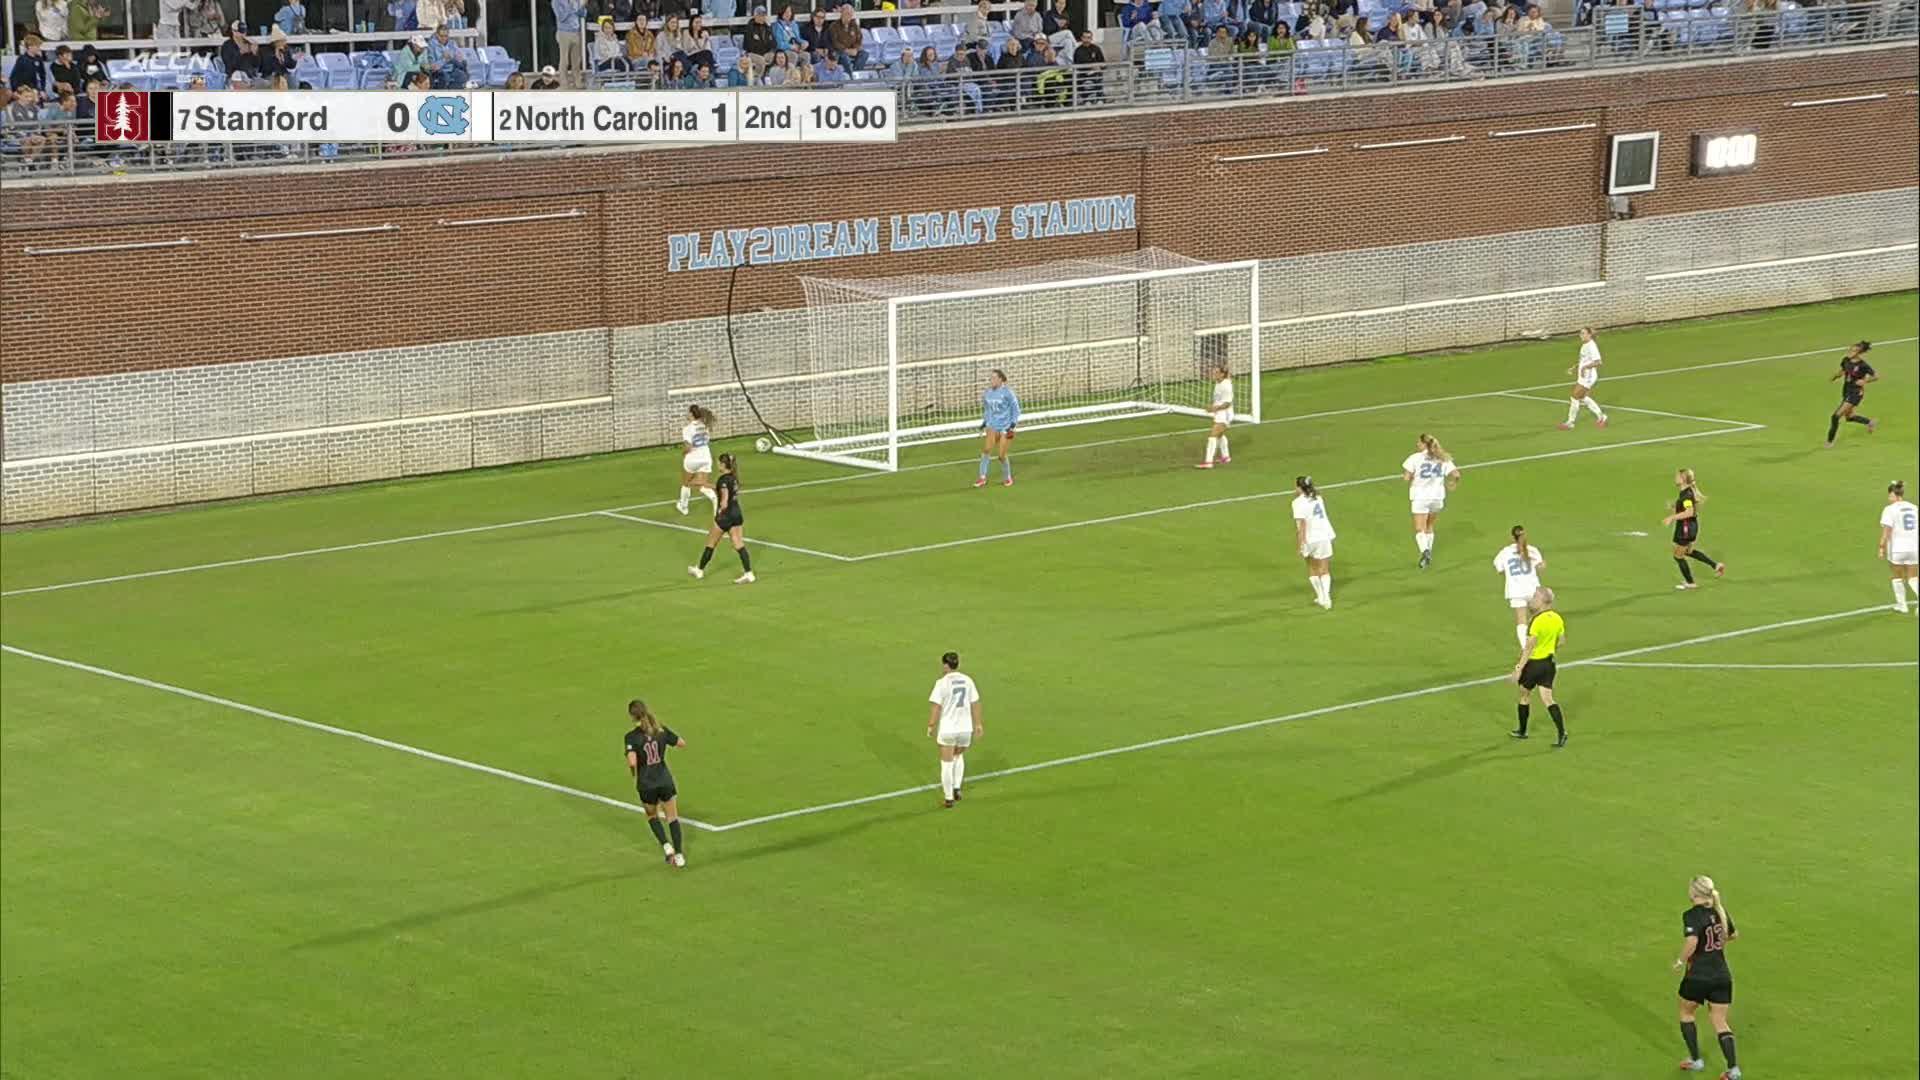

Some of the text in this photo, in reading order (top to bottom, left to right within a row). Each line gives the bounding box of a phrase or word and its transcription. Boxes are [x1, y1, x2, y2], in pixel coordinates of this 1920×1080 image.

[668, 194, 1136, 272] PLAY2DREAM LEGACY STADIUM
[1420, 463, 1442, 479] 24
[1312, 503, 1324, 519] 4
[1507, 557, 1532, 576] 20
[952, 687, 966, 708] 7
[643, 740, 661, 765] 11
[1704, 923, 1724, 952] 13
